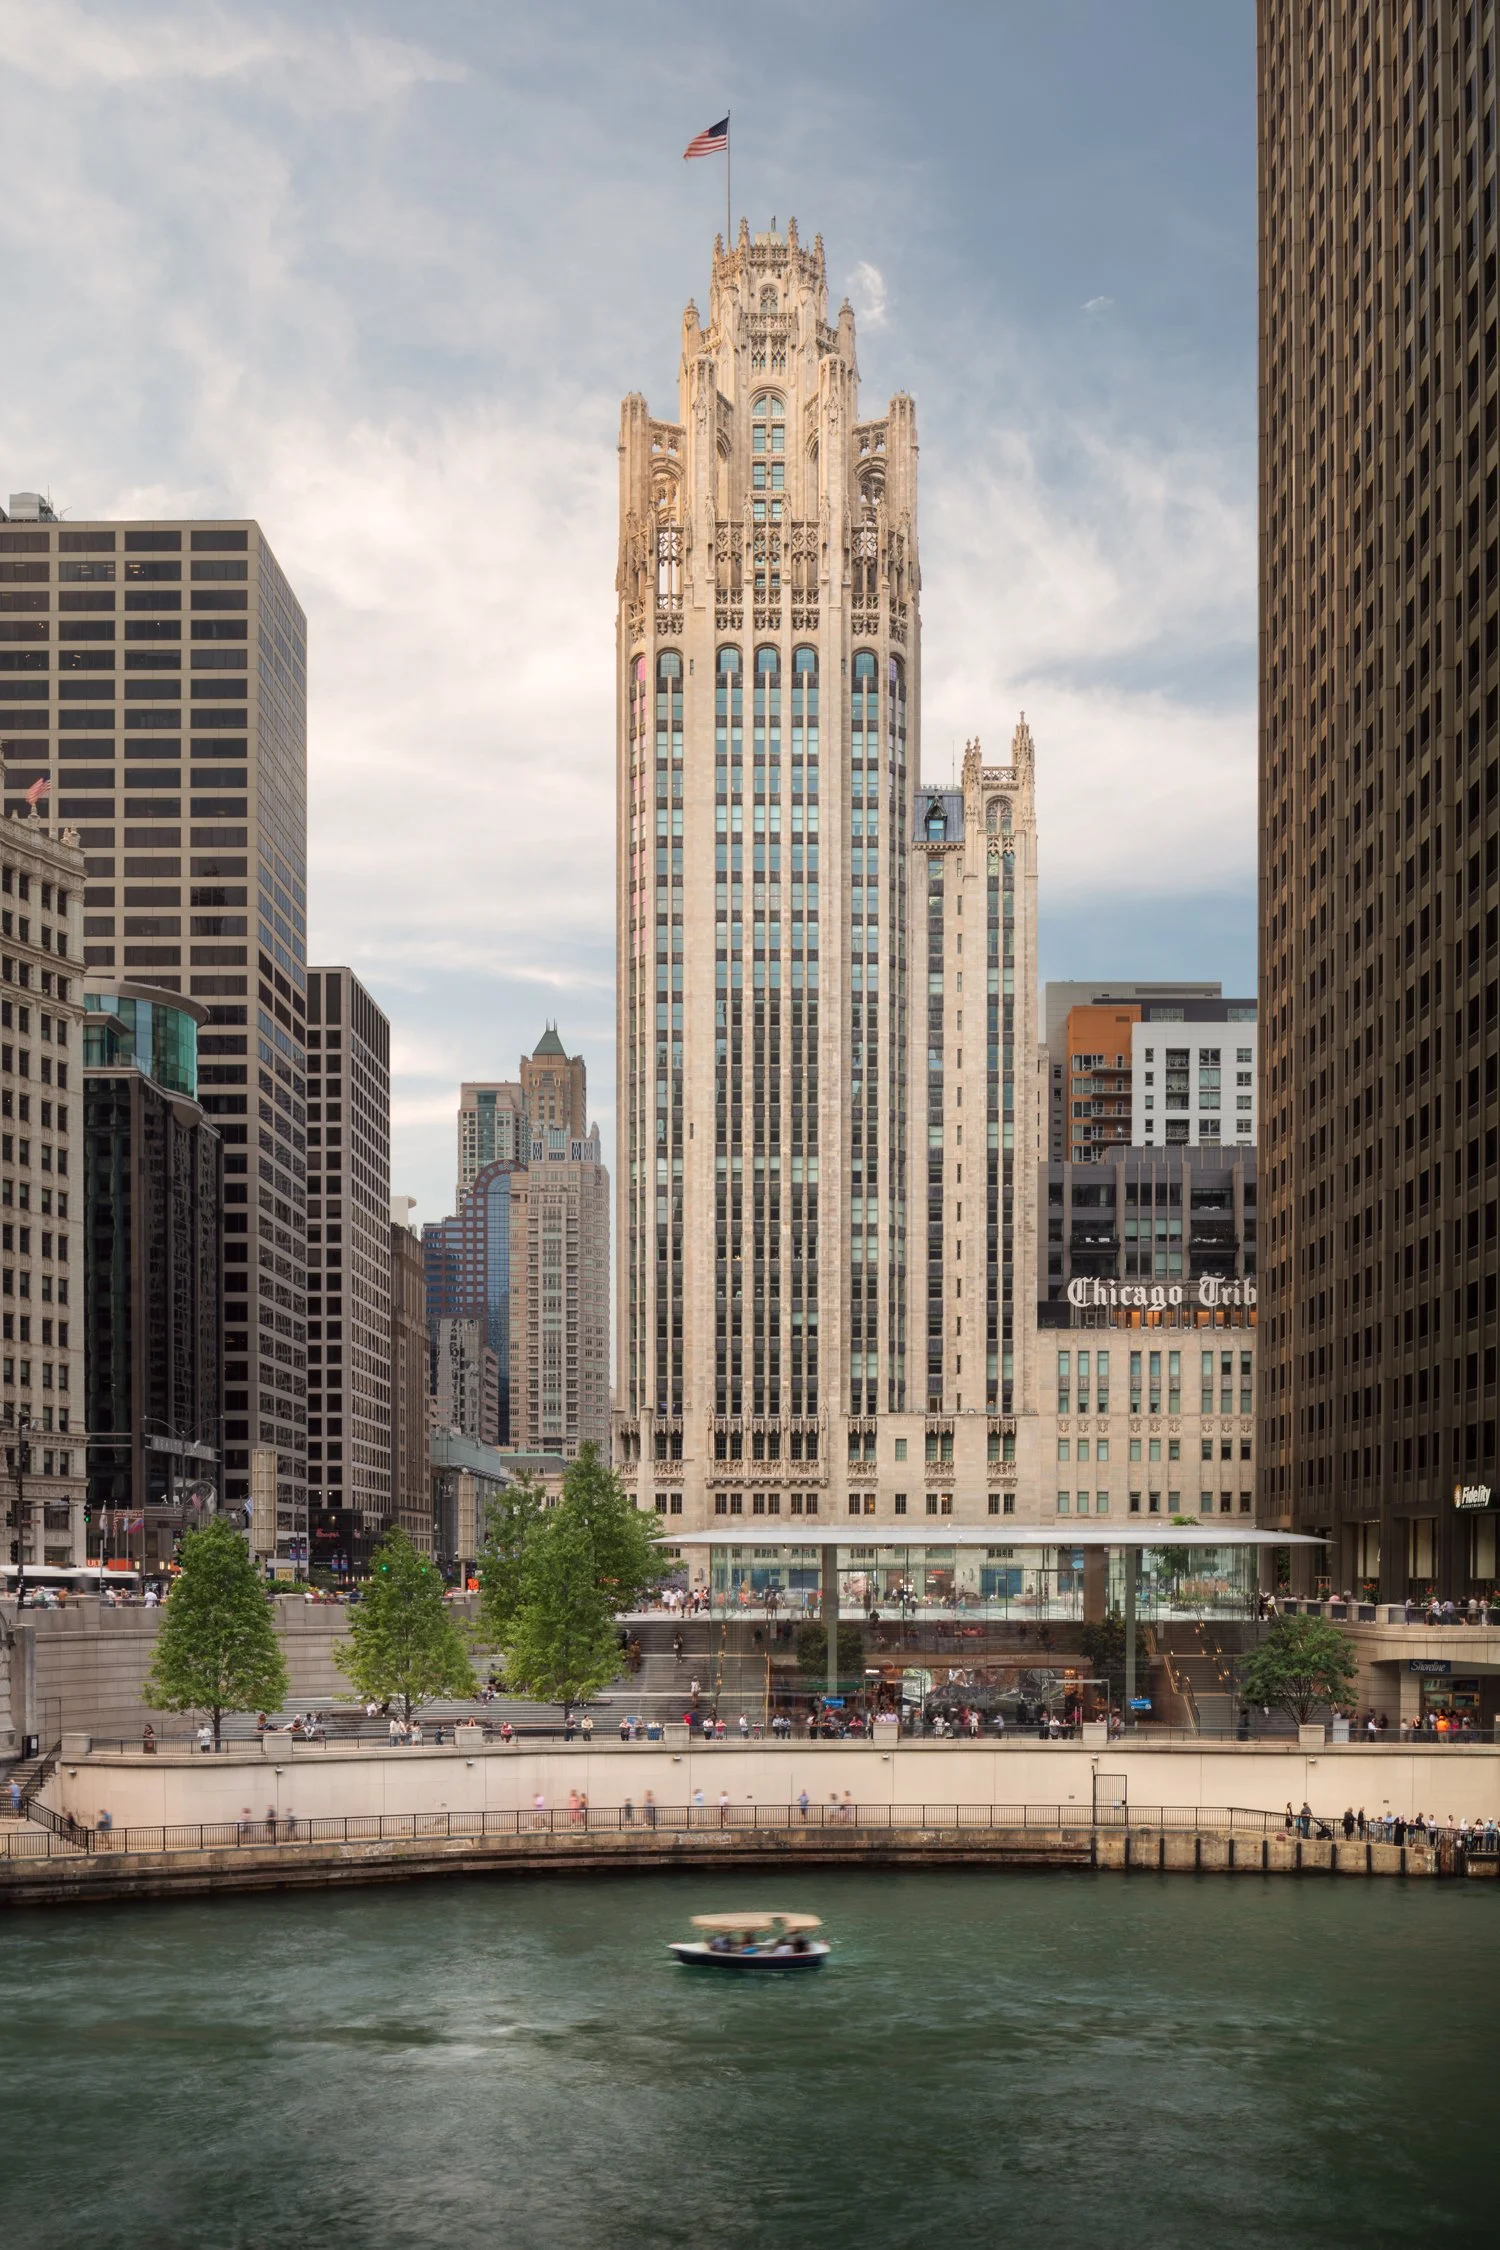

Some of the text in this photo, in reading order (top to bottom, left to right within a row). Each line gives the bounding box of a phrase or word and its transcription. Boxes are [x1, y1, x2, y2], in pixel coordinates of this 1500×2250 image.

[1067, 1276, 1183, 1312] Chicago
[1461, 1484, 1491, 1507] Fidelity
[1410, 1660, 1447, 1672] Shoreline
